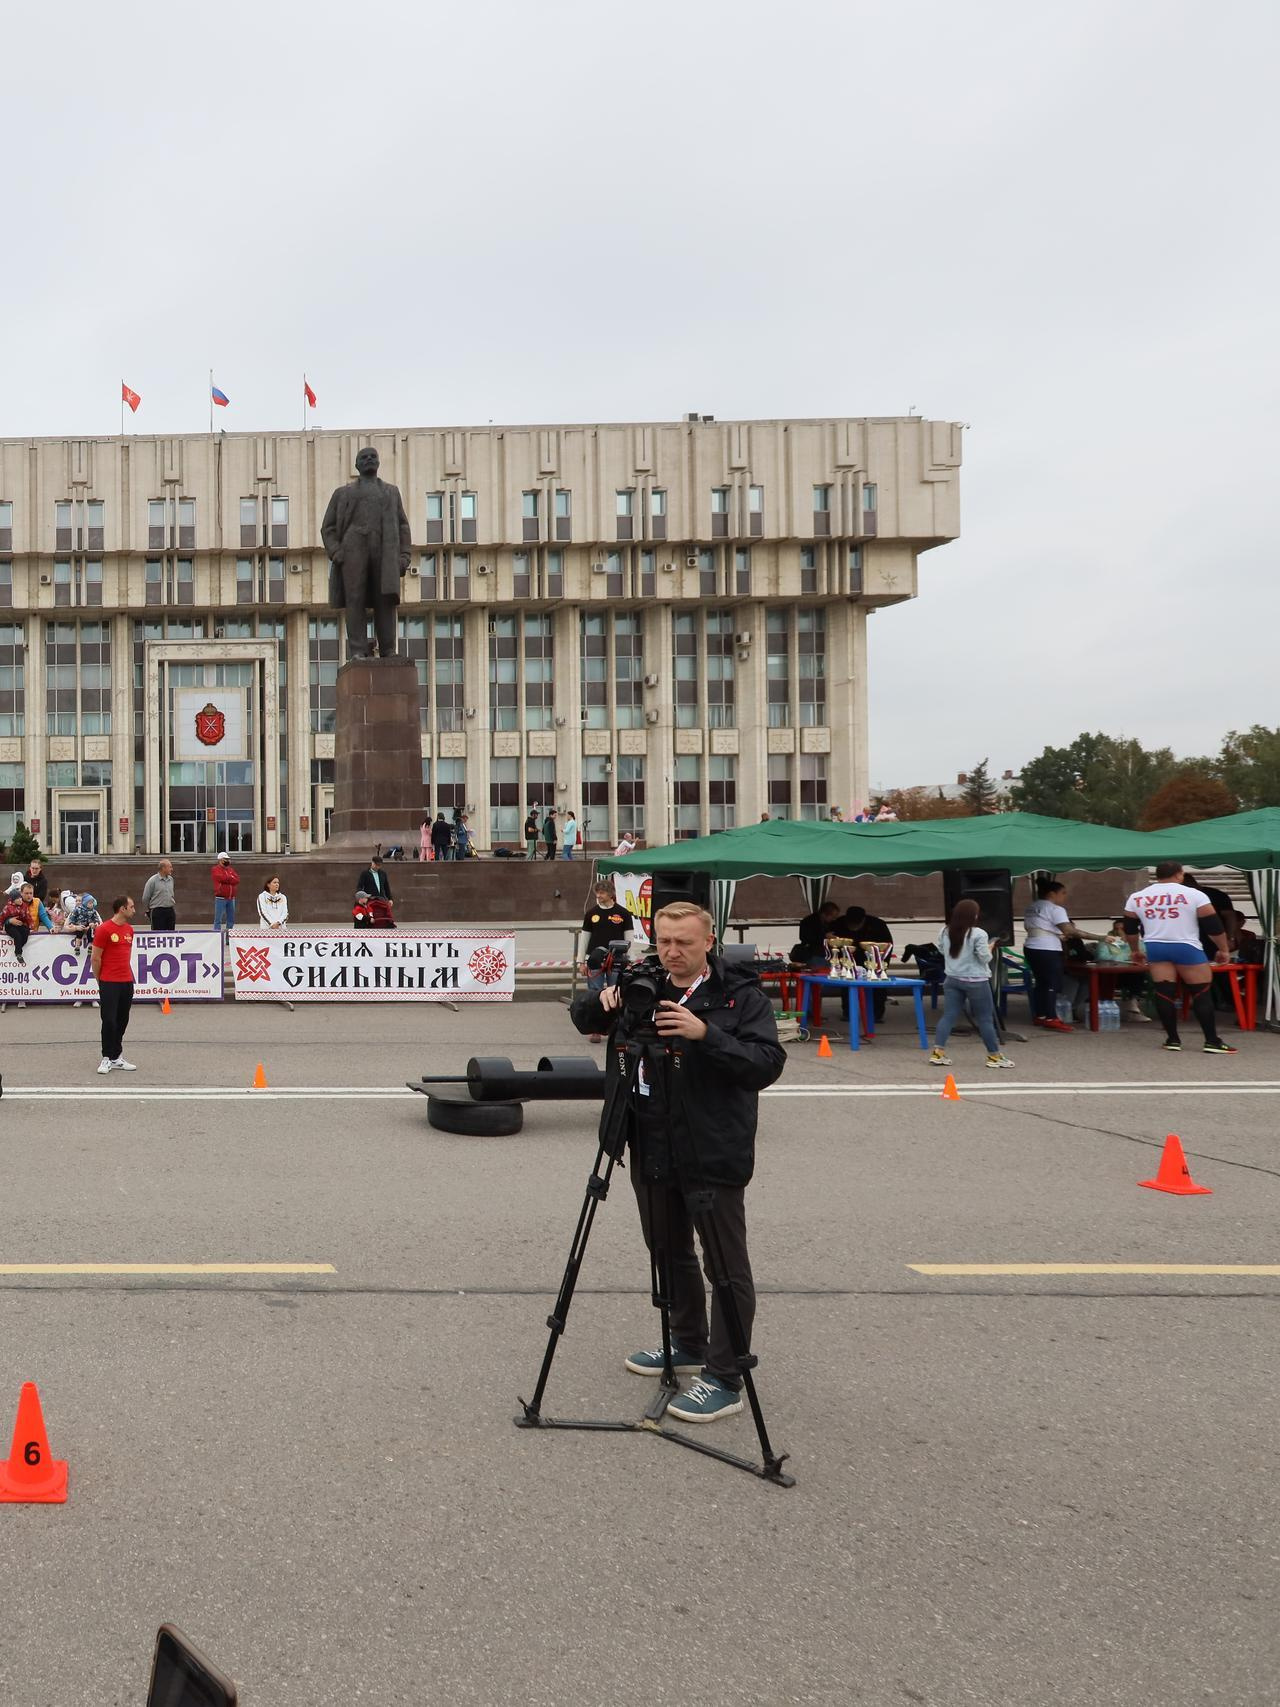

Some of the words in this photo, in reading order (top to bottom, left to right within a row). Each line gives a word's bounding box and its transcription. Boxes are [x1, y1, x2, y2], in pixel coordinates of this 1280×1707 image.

[1134, 892, 1188, 908] ТУЛА
[1144, 907, 1180, 919] 875
[136, 936, 186, 949] ЦЕНТР
[384, 942, 460, 958] БЫТЬ
[282, 965, 462, 989] СИЛЬНЫМ
[618, 1051, 627, 1077] SONY
[24, 1441, 41, 1466] 6
